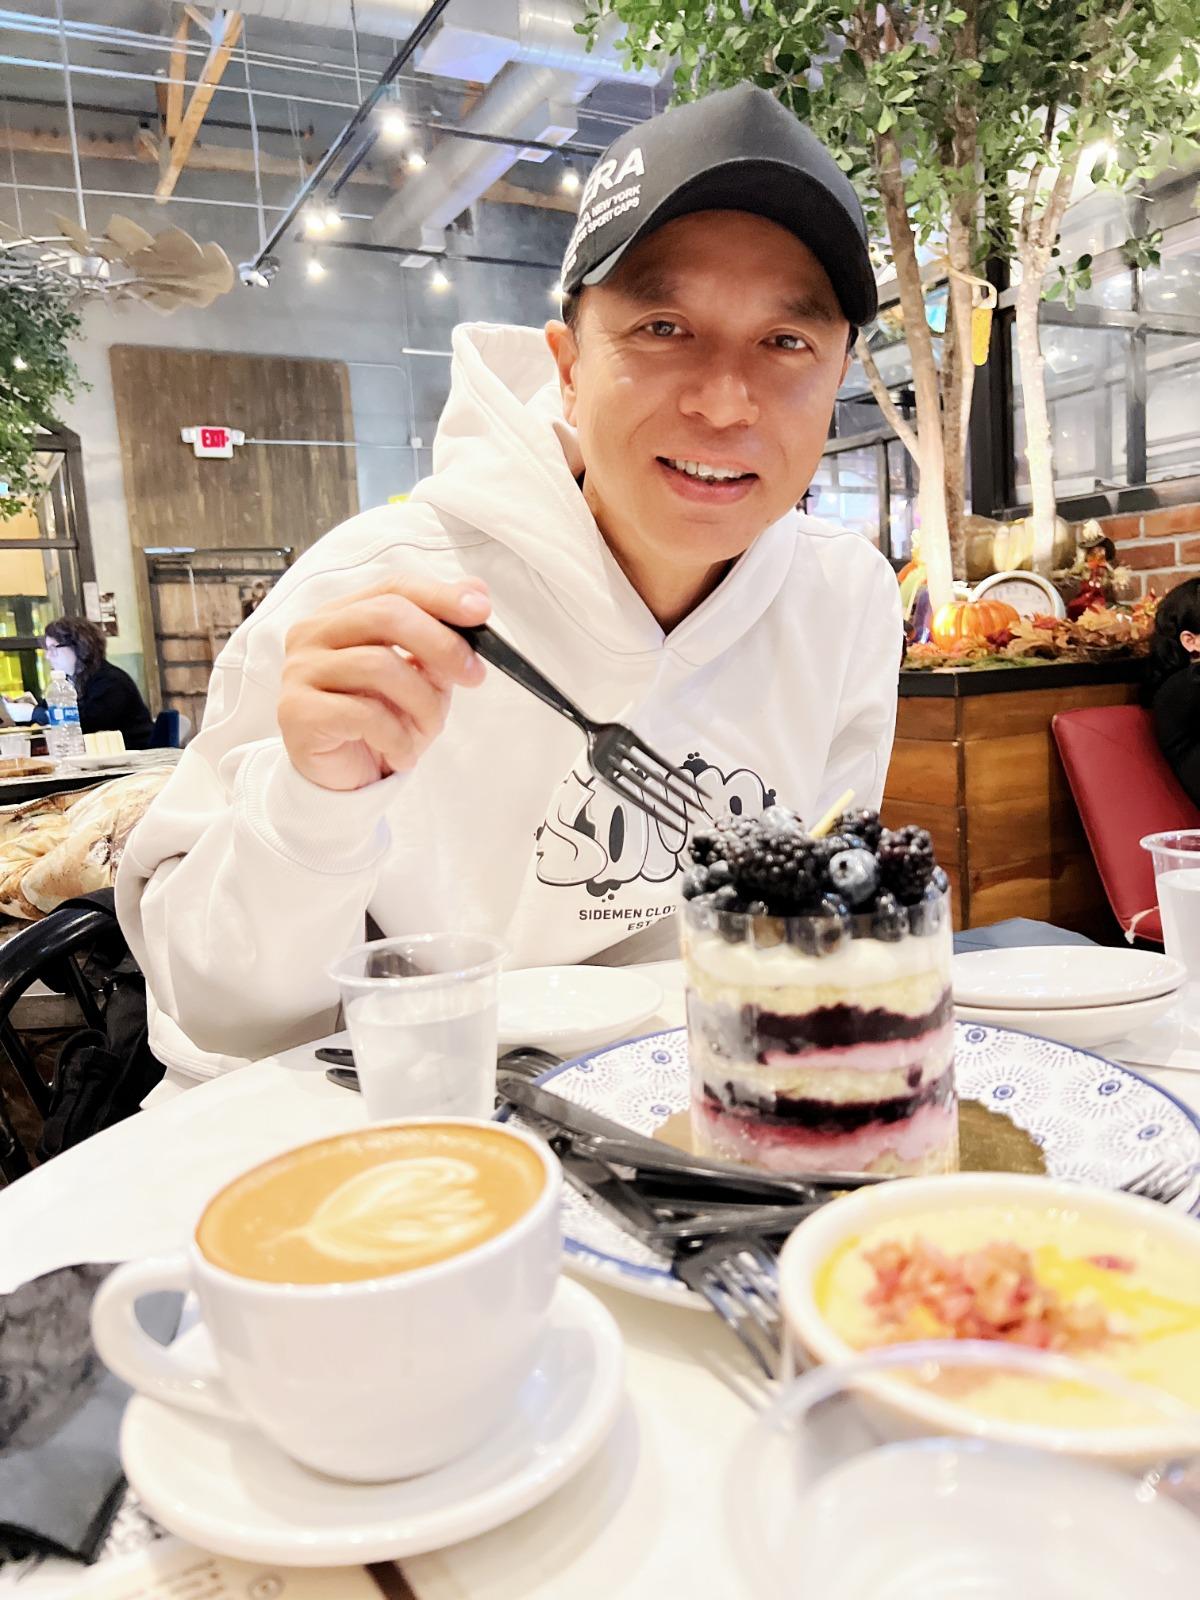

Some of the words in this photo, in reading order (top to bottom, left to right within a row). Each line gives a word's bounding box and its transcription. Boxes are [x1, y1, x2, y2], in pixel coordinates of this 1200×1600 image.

[587, 209, 613, 233] SPORT
[613, 196, 640, 217] CAPS
[591, 198, 612, 218] NEW
[611, 184, 641, 205] YORK
[579, 908, 642, 921] SIDEMEN
